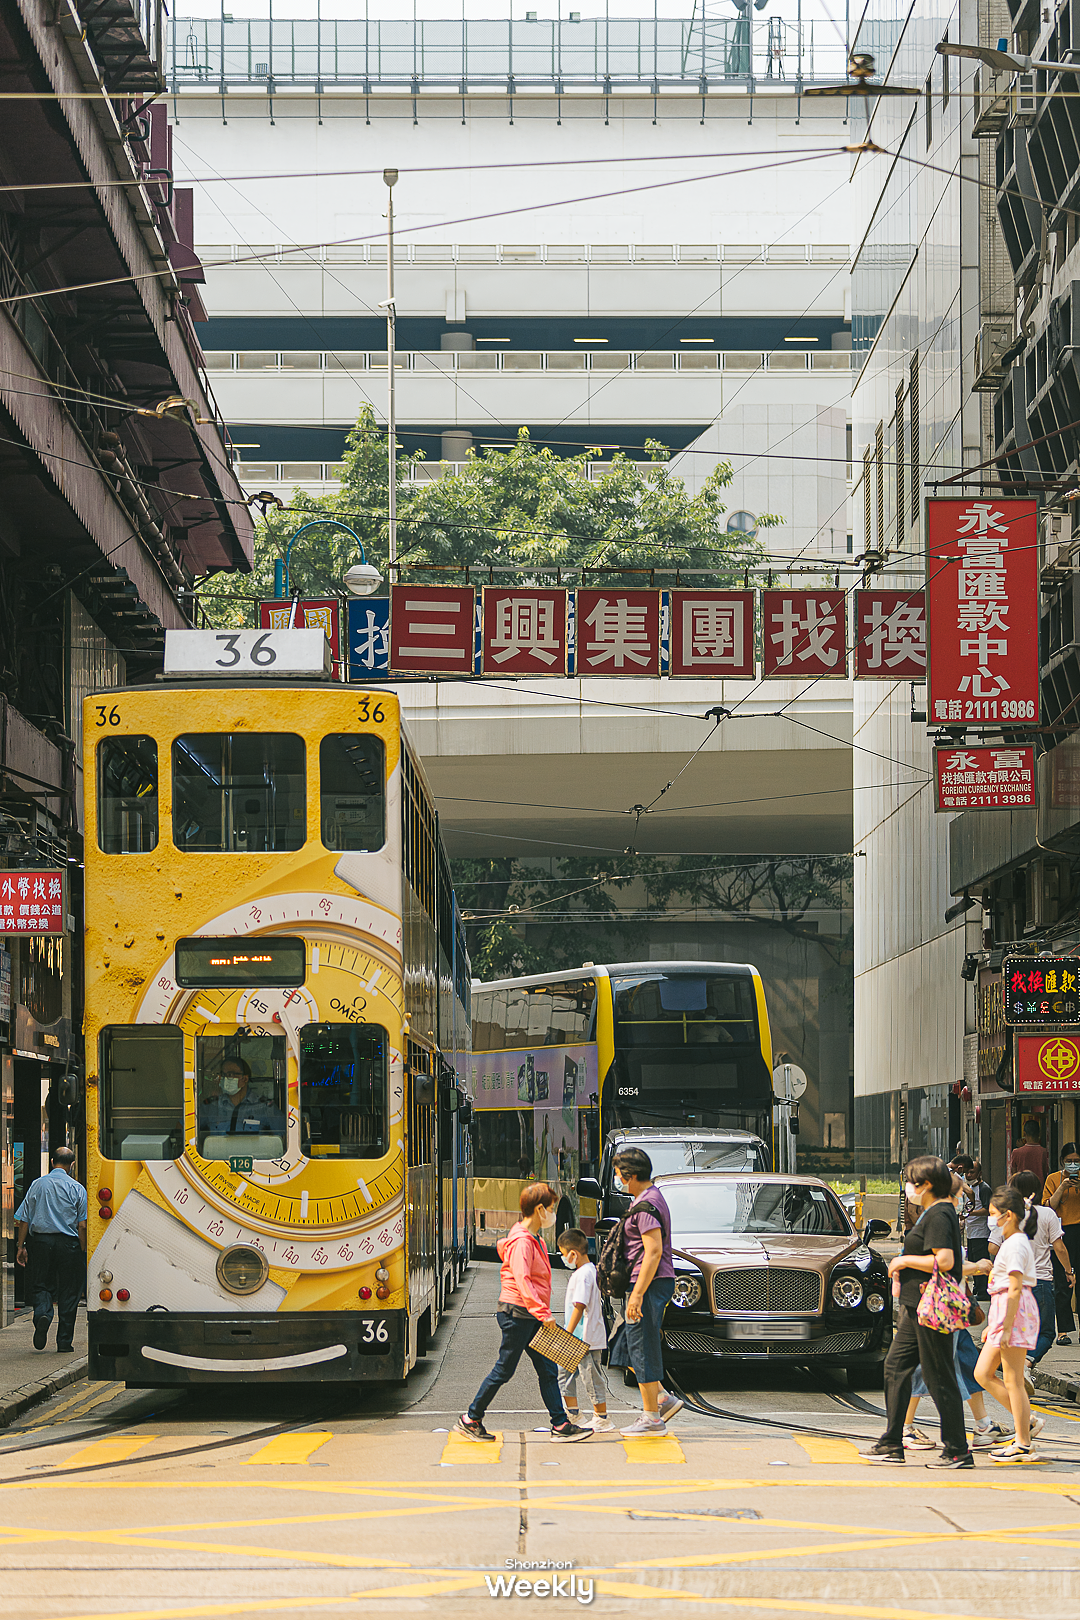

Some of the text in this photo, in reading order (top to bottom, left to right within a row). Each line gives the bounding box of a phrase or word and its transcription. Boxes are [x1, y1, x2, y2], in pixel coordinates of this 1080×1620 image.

[956, 503, 1011, 697] 永富匯款中心
[398, 598, 926, 668] 三興集團找換
[215, 633, 277, 667] 36
[95, 705, 121, 726] 36
[358, 702, 385, 723] 36
[935, 699, 1034, 719] 電話 2111 3986
[945, 750, 1026, 770] 永富
[941, 769, 1031, 785] 找換匯款有限公司
[942, 783, 1032, 795] FOREIGN CURRENCY EXCHANGE
[943, 794, 1031, 806] 電話 2111 3986
[1, 876, 62, 900] 外幣找換
[0, 904, 62, 916] 款 價錢公道
[249, 905, 263, 920] 70
[318, 898, 333, 912] 65
[157, 976, 171, 990] 80
[1011, 969, 1077, 993] 找換匯款
[249, 998, 269, 1014] 45
[618, 1087, 639, 1096] 6354
[1023, 1080, 1043, 1090] 電話
[1045, 1081, 1069, 1090] 2111
[232, 1158, 251, 1169] 126
[174, 1190, 189, 1204] 110
[243, 1192, 261, 1206] MADE
[207, 1220, 225, 1237] 120
[358, 1238, 375, 1255] 170
[377, 1230, 394, 1247] 180
[281, 1247, 300, 1265] 140
[310, 1248, 329, 1265] 150
[336, 1245, 354, 1262] 160
[362, 1319, 389, 1342] 36
